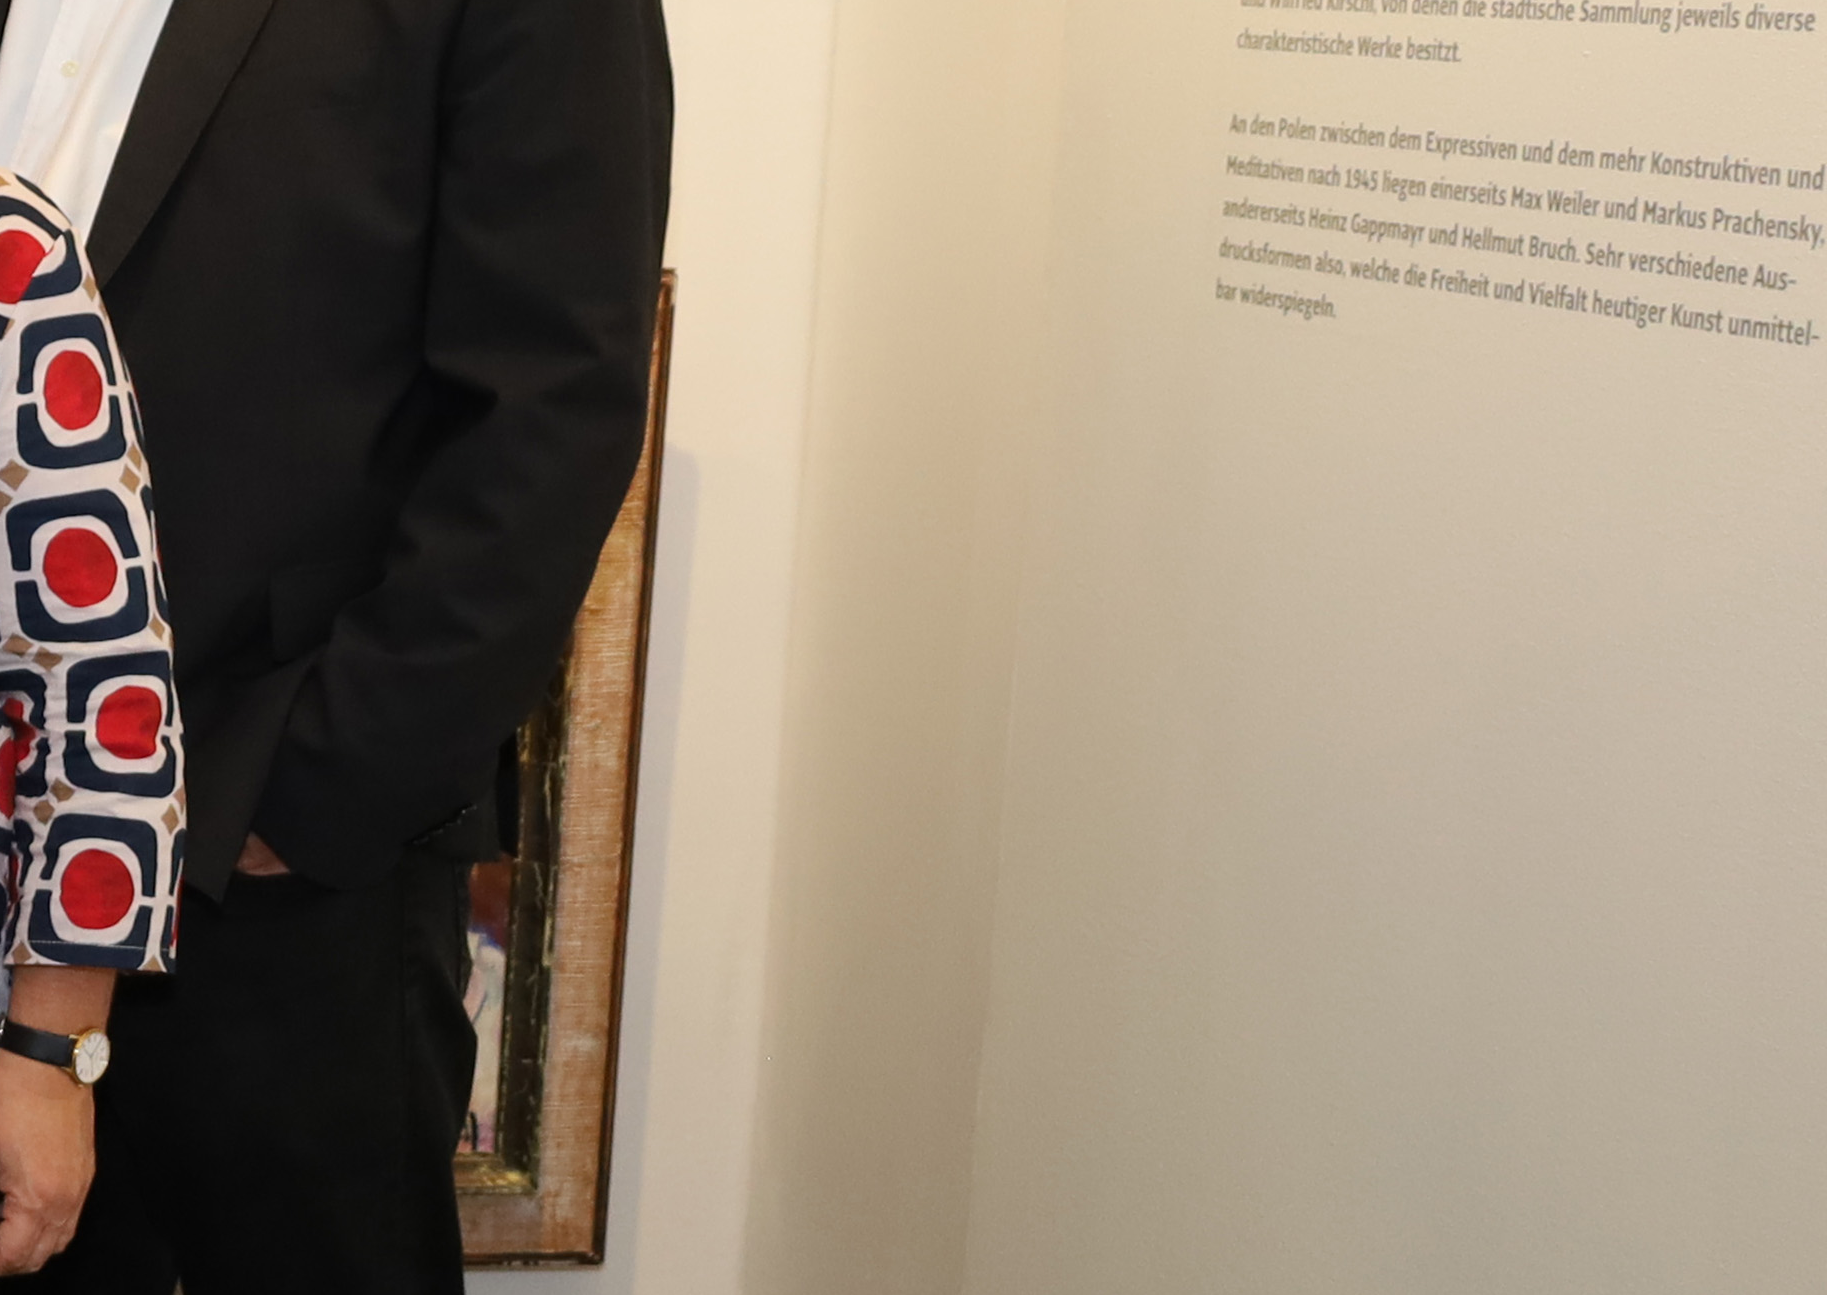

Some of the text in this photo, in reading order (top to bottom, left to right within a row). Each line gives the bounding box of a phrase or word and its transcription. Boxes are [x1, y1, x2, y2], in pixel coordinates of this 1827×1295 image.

[1236, 27, 1355, 57] charakteristische
[1356, 35, 1404, 60] Werke
[1674, 0, 1741, 34] jeweils
[1744, 2, 1817, 33] diverse
[1319, 121, 1386, 148] zwischen
[1388, 125, 1422, 152] dem
[1425, 130, 1518, 162] Expressiven
[1521, 139, 1555, 165] und
[1556, 141, 1595, 169] dem
[1598, 146, 1647, 174] mehr
[1649, 150, 1782, 187] Konstruktiven
[1786, 164, 1826, 192] und
[1344, 168, 1379, 193] 1945
[1381, 169, 1427, 203] liegen
[1429, 176, 1507, 208] einerseits
[1510, 185, 1544, 211] Max
[1546, 189, 1601, 218] Weiler
[1603, 196, 1639, 223] und
[1641, 200, 1708, 231] Markus
[1308, 207, 1348, 234] Heinz
[1350, 212, 1426, 249] Gappmayr
[1427, 223, 1459, 248] und
[1461, 226, 1525, 258] Hellmut
[1584, 242, 1626, 270] Sehr
[1628, 251, 1749, 287] verschiedene
[1751, 264, 1797, 292] Aus-
[1349, 257, 1401, 285] welche
[1403, 263, 1428, 289] die
[1430, 268, 1490, 299] Freiheit
[1493, 278, 1526, 304] und
[1528, 281, 1589, 314] Vielfalt
[1591, 289, 1668, 330] heutiger
[1670, 303, 1724, 335] Kunst
[1727, 314, 1820, 347] unmittel-
